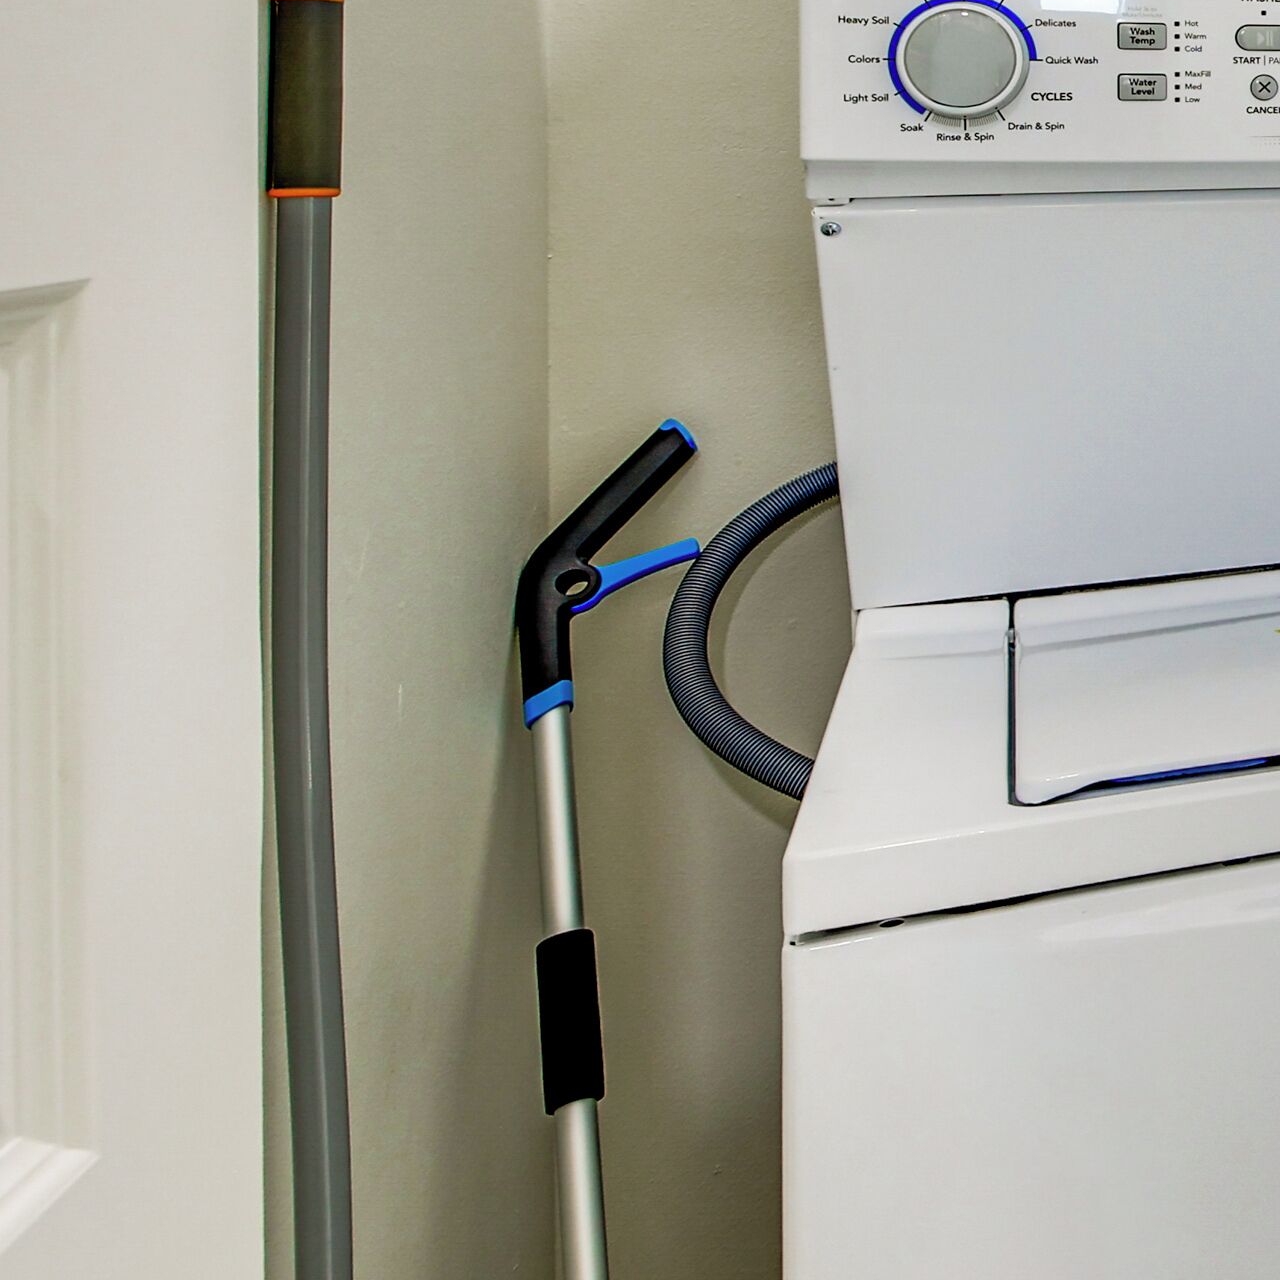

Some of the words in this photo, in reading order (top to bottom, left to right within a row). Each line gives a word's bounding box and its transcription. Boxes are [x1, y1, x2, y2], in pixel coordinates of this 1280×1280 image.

[838, 15, 869, 26] Heavy
[871, 16, 890, 25] Soil
[1035, 19, 1077, 28] Delicates
[1129, 27, 1156, 36] Wash
[1129, 36, 1156, 46] Temp
[1184, 45, 1203, 53] Cold
[848, 55, 881, 64] Colors
[1045, 55, 1072, 66] Quick
[1074, 56, 1099, 65] Wash
[1232, 56, 1261, 65] START
[1128, 78, 1157, 87] Water
[1130, 87, 1155, 96] Level
[843, 93, 869, 105] Light
[871, 93, 890, 103] Soil
[1031, 92, 1073, 102] CYCLES
[900, 123, 924, 132] Soak
[1008, 122, 1033, 131] Drain
[1035, 122, 1042, 131] &
[1043, 121, 1065, 132] Spin
[936, 132, 962, 142] Rinse
[964, 132, 972, 142] &
[974, 132, 995, 143] Spin
